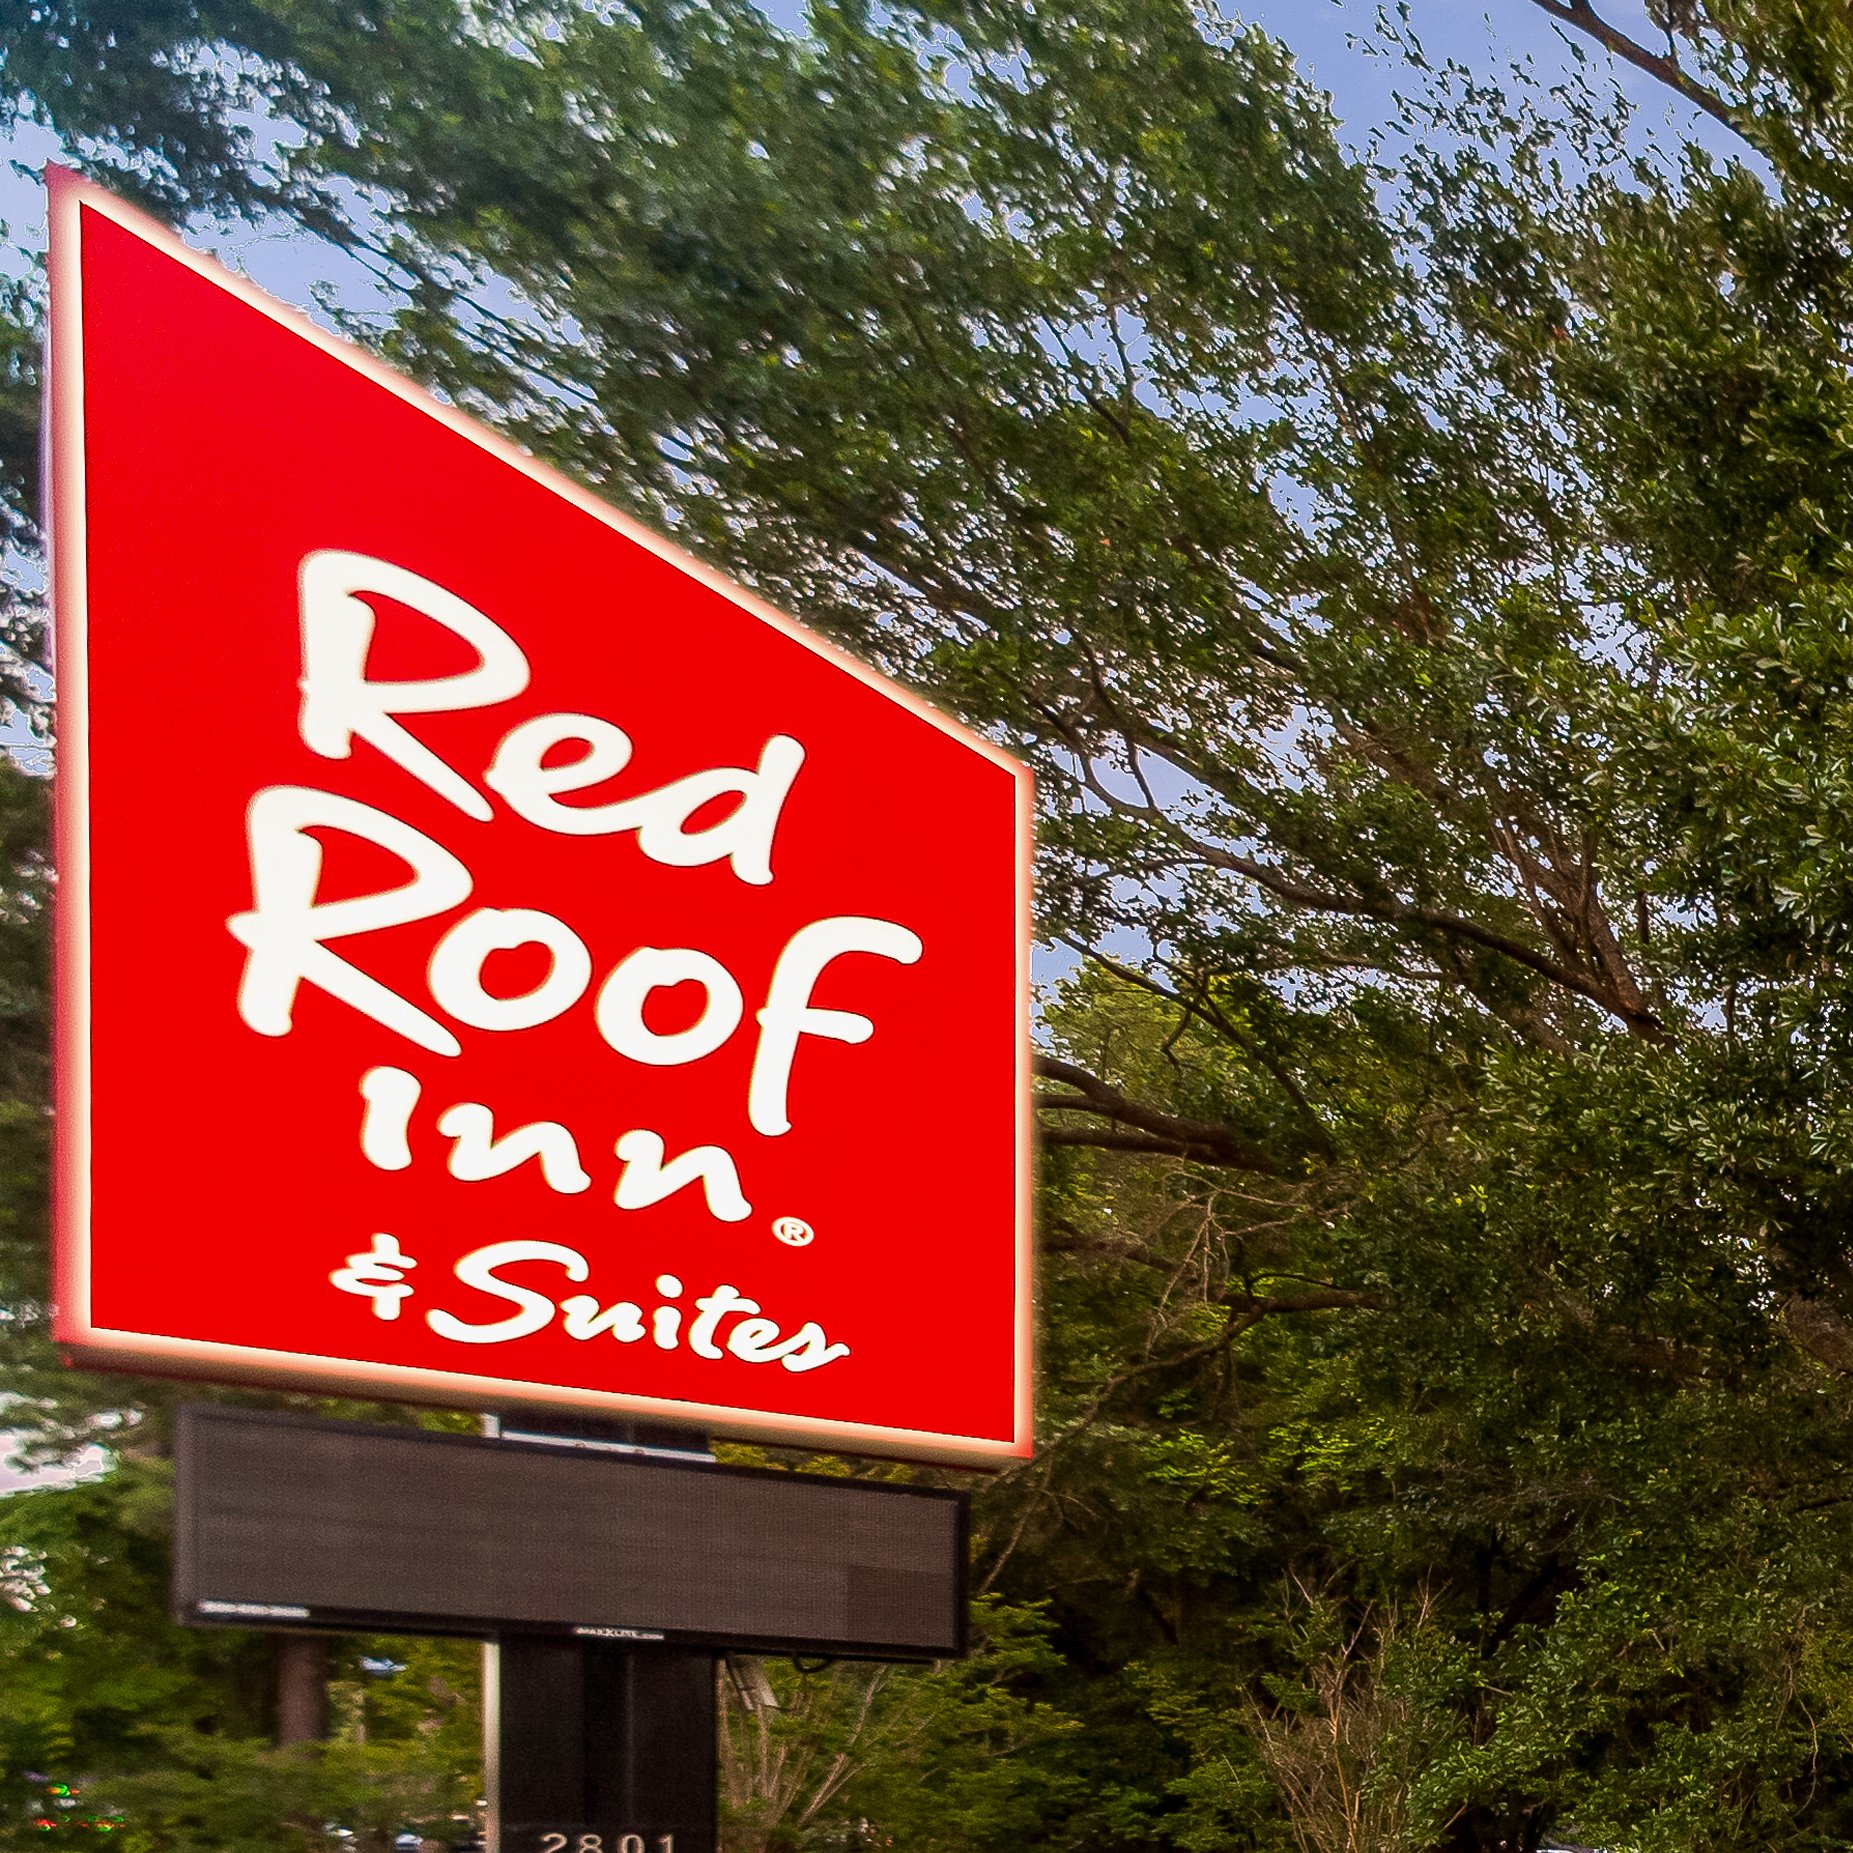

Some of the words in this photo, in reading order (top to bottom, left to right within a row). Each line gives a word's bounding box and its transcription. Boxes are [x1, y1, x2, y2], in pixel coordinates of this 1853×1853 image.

[297, 549, 806, 886] Red
[225, 784, 925, 1138] Roof
[329, 1232, 418, 1321] &
[424, 1238, 852, 1374] Suites
